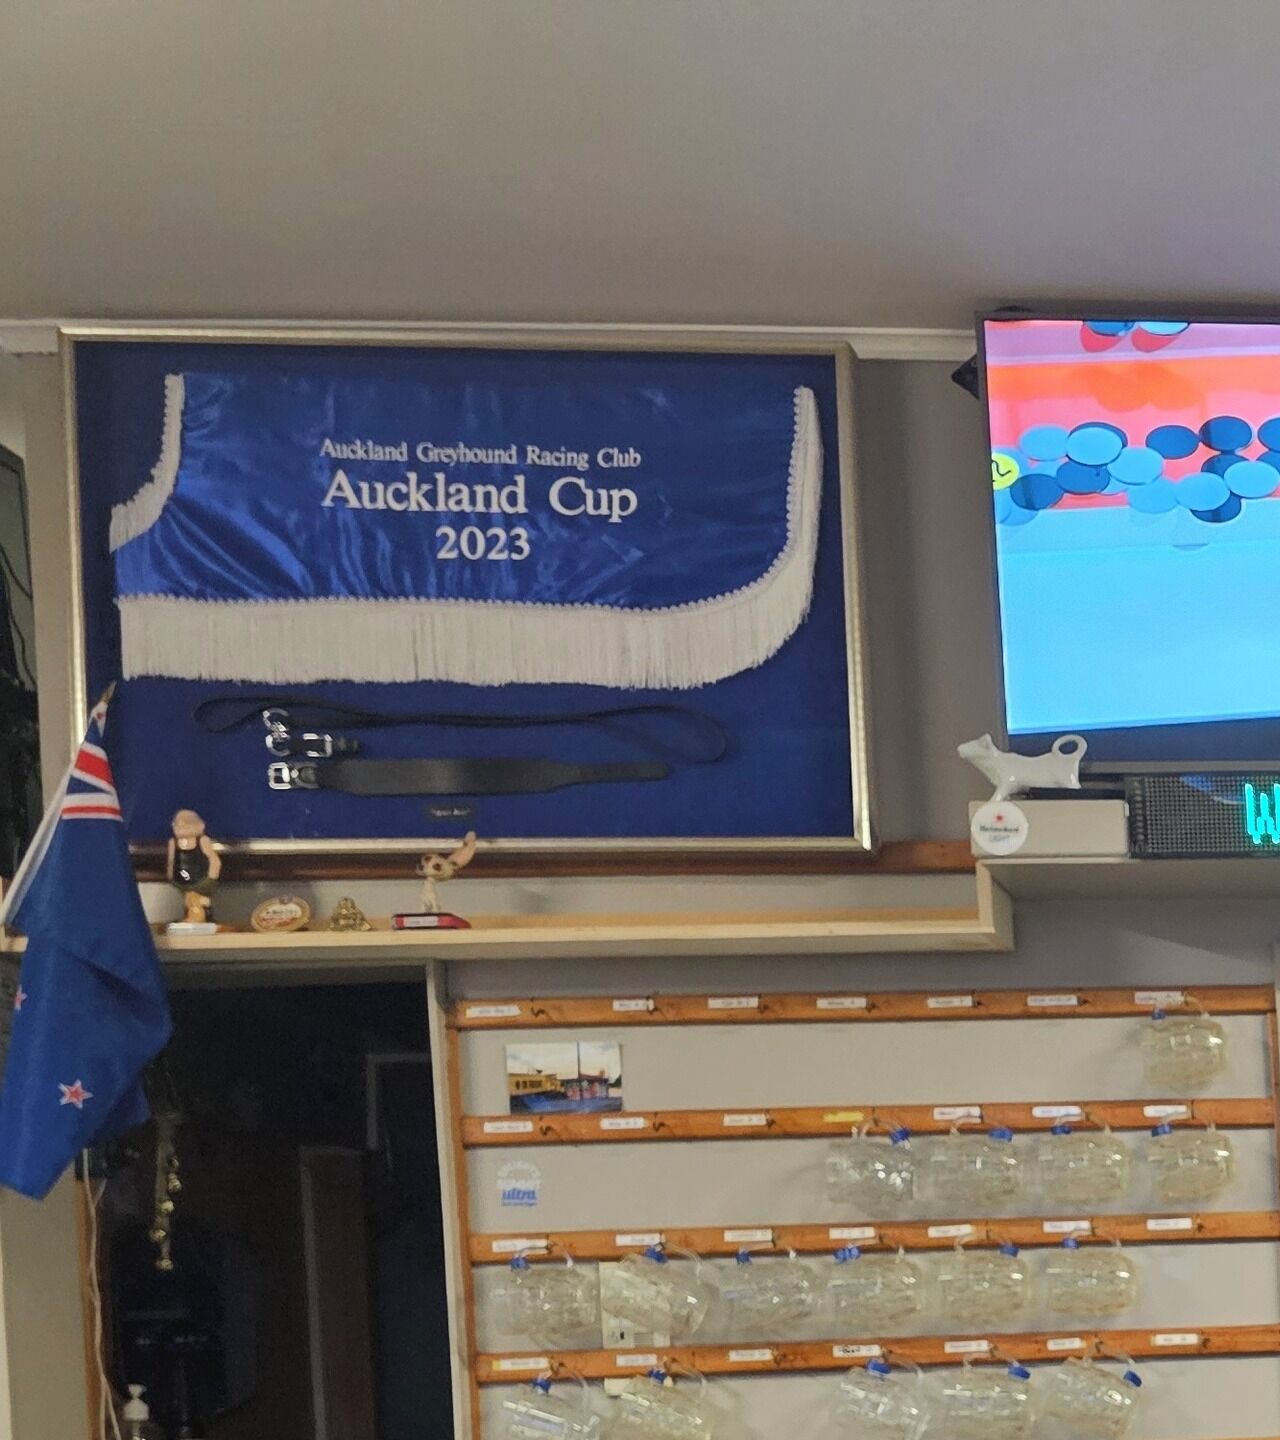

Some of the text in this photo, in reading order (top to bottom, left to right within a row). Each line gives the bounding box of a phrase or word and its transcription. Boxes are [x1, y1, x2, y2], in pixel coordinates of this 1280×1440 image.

[320, 438, 641, 471] Auckland Greyhound Racing Club
[321, 468, 638, 523] Auckland Cup
[435, 526, 531, 561] 2023
